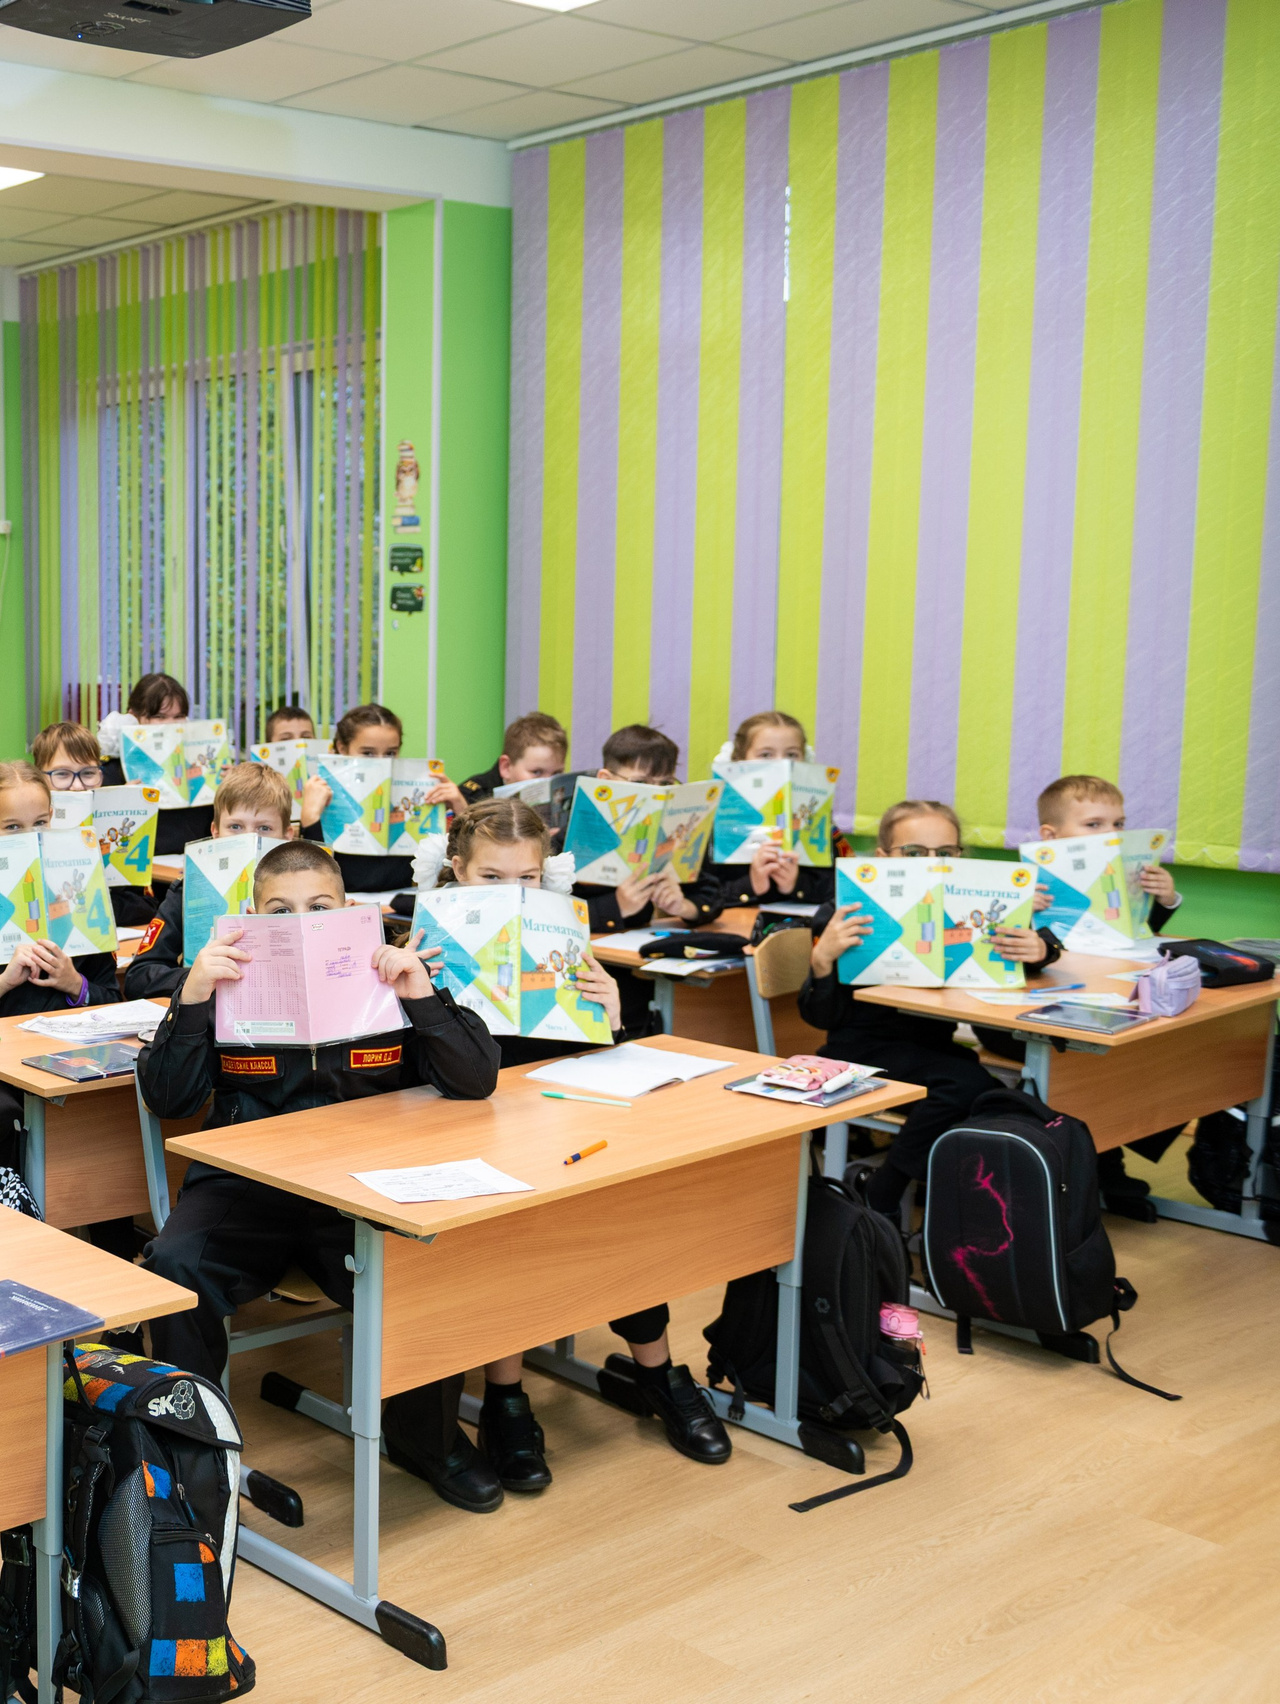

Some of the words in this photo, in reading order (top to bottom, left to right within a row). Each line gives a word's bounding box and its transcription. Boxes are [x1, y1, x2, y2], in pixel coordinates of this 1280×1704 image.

[680, 832, 705, 870] 4
[809, 815, 829, 853] 4
[124, 834, 151, 873] 4
[945, 884, 1021, 900] Математика
[86, 888, 111, 935] 4
[521, 917, 586, 941] Математика
